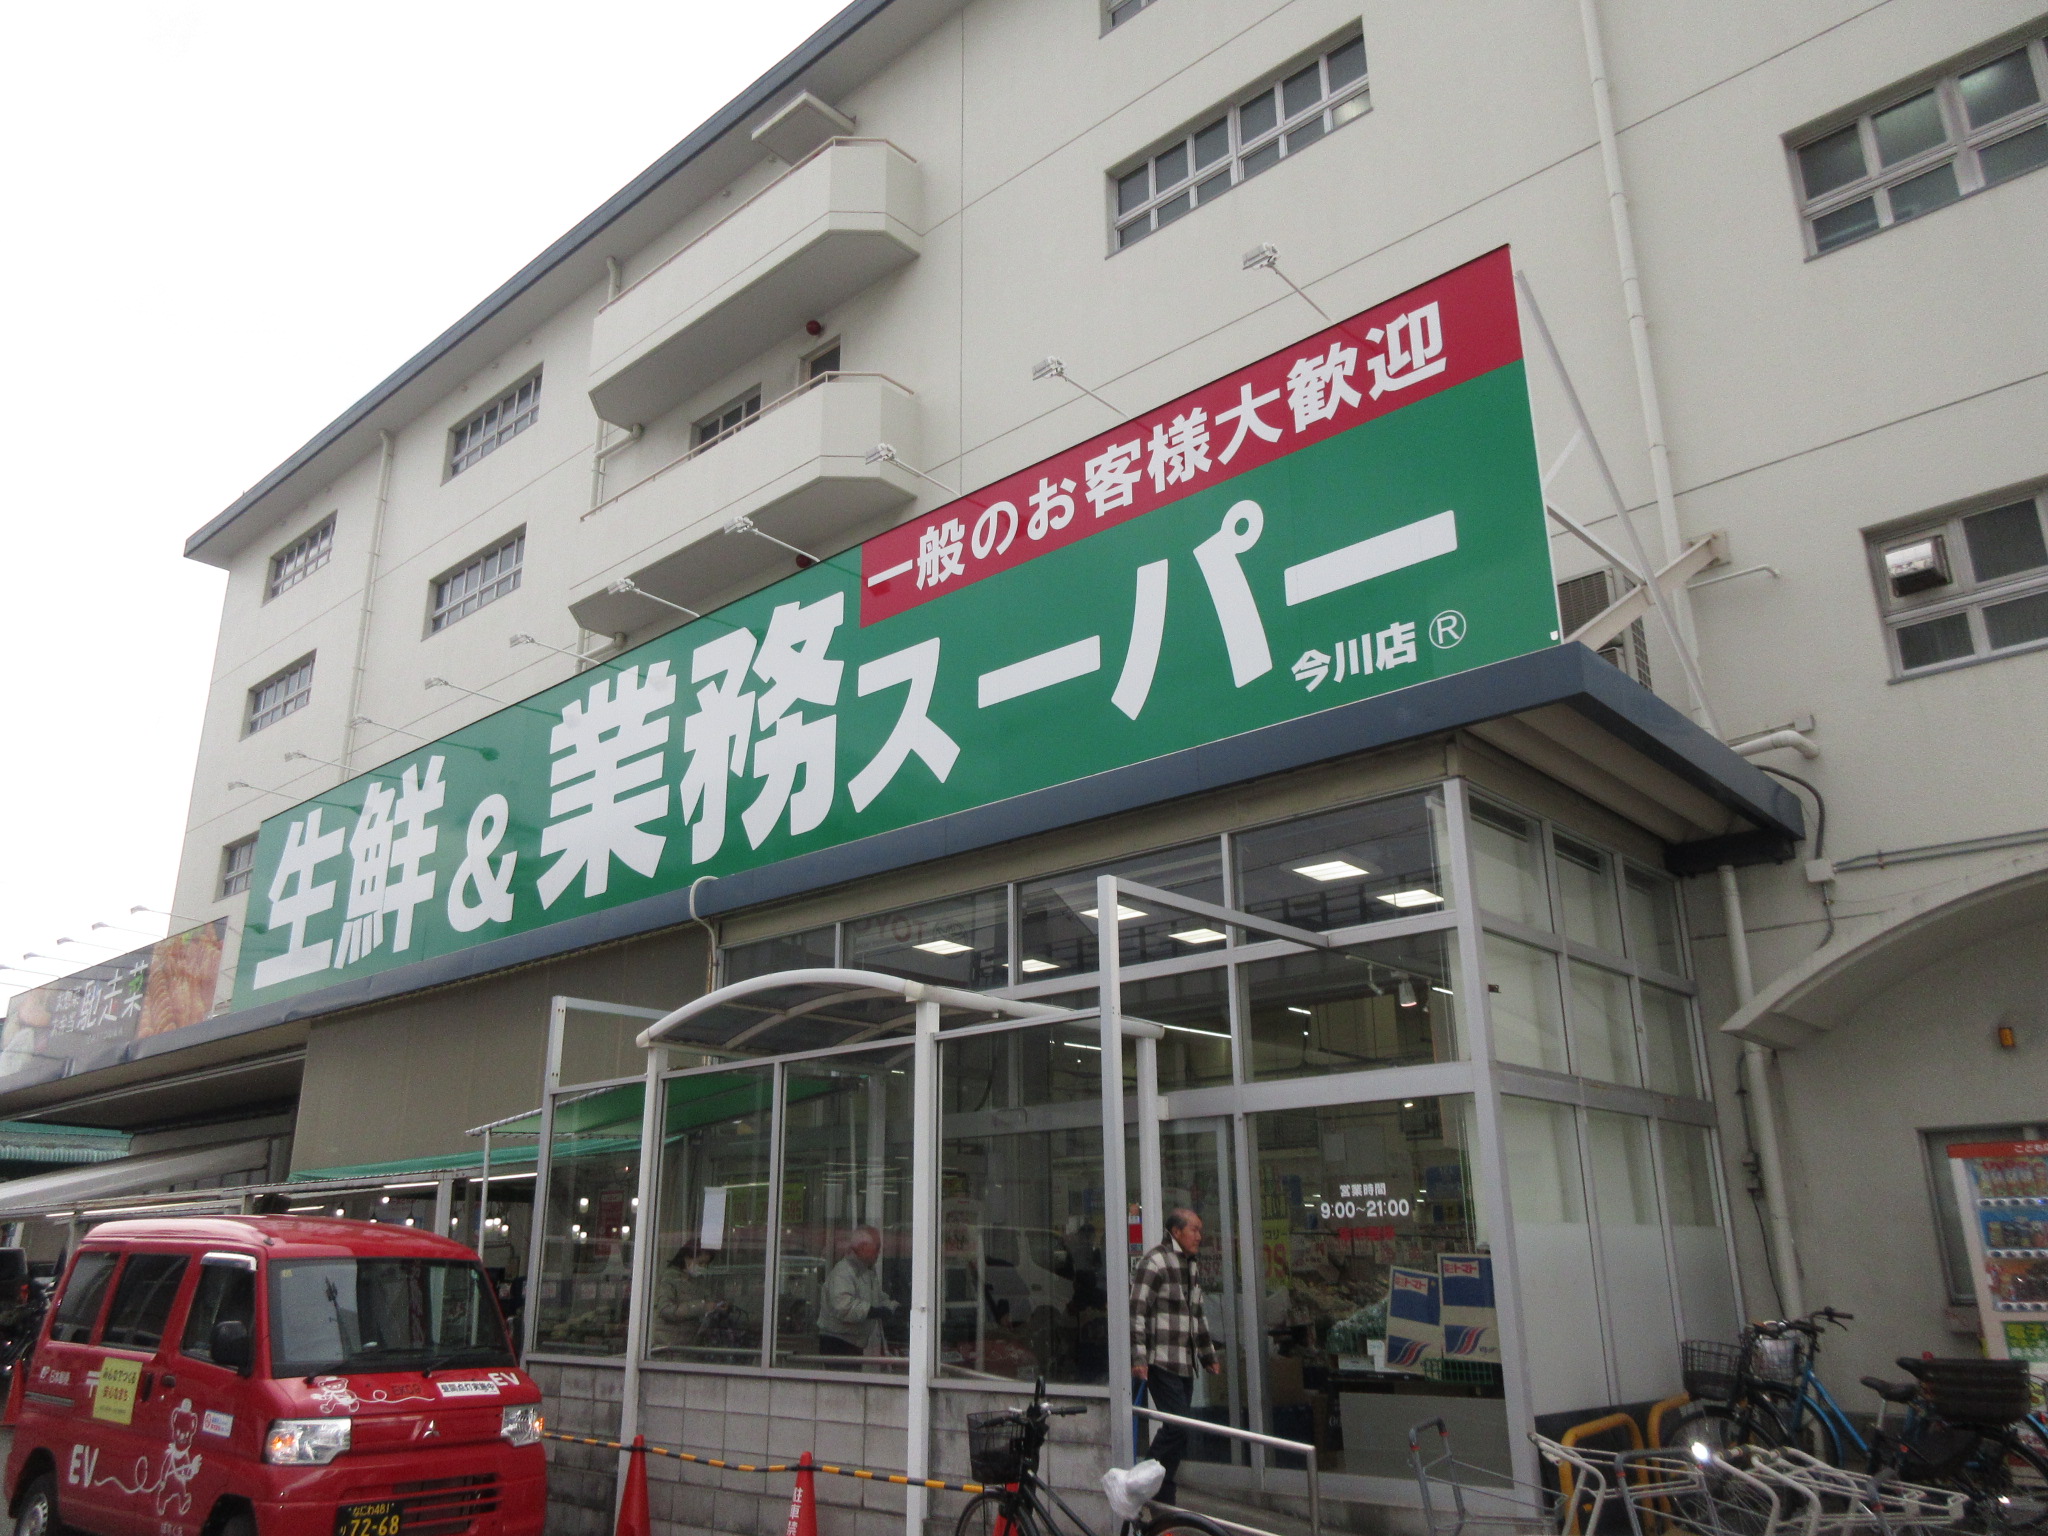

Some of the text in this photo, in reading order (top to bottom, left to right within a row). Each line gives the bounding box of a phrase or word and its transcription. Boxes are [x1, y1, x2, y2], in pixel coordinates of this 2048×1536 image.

[868, 301, 1447, 590] 一般のお客様大歓迎
[1291, 621, 1417, 693] 今川店
[1340, 1182, 1387, 1198] 営業時間
[1320, 1199, 1410, 1219] 9:00~21:00
[488, 1372, 520, 1387] EV
[69, 1443, 100, 1488] EV
[350, 1515, 400, 1536] 72-68
